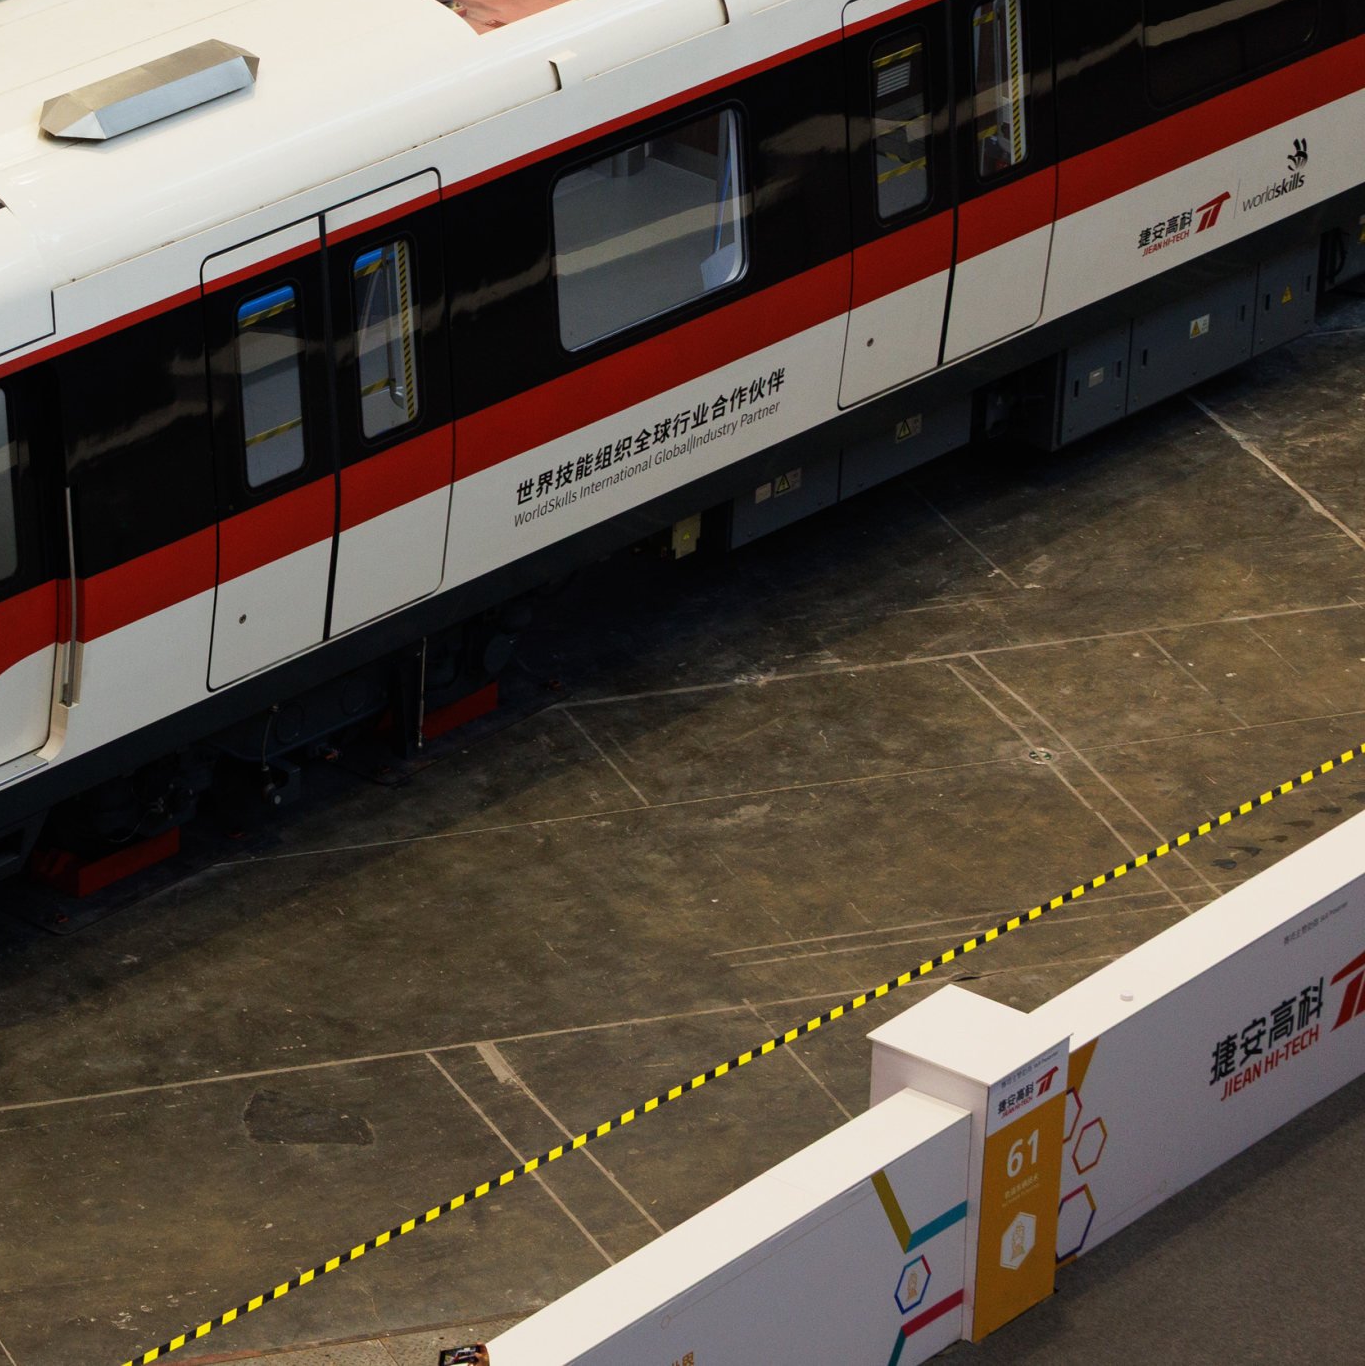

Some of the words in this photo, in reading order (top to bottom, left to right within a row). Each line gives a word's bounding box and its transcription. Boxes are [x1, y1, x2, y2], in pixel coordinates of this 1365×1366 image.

[1242, 171, 1305, 212] worldskills
[1137, 208, 1193, 249] 捷安高科
[1142, 242, 1162, 257] JIEAN
[1162, 229, 1190, 249] HI-TECH
[514, 489, 578, 528] WorldSkills
[579, 453, 652, 501] International
[740, 400, 781, 428] Partner
[515, 367, 786, 506] 世界技能组织全球行业合作伙伴
[1209, 976, 1325, 1086] 捷安高科
[1221, 1059, 1262, 1102] JIEAN
[1264, 1023, 1320, 1075] HI-TECH
[1006, 1128, 1039, 1178] 61
